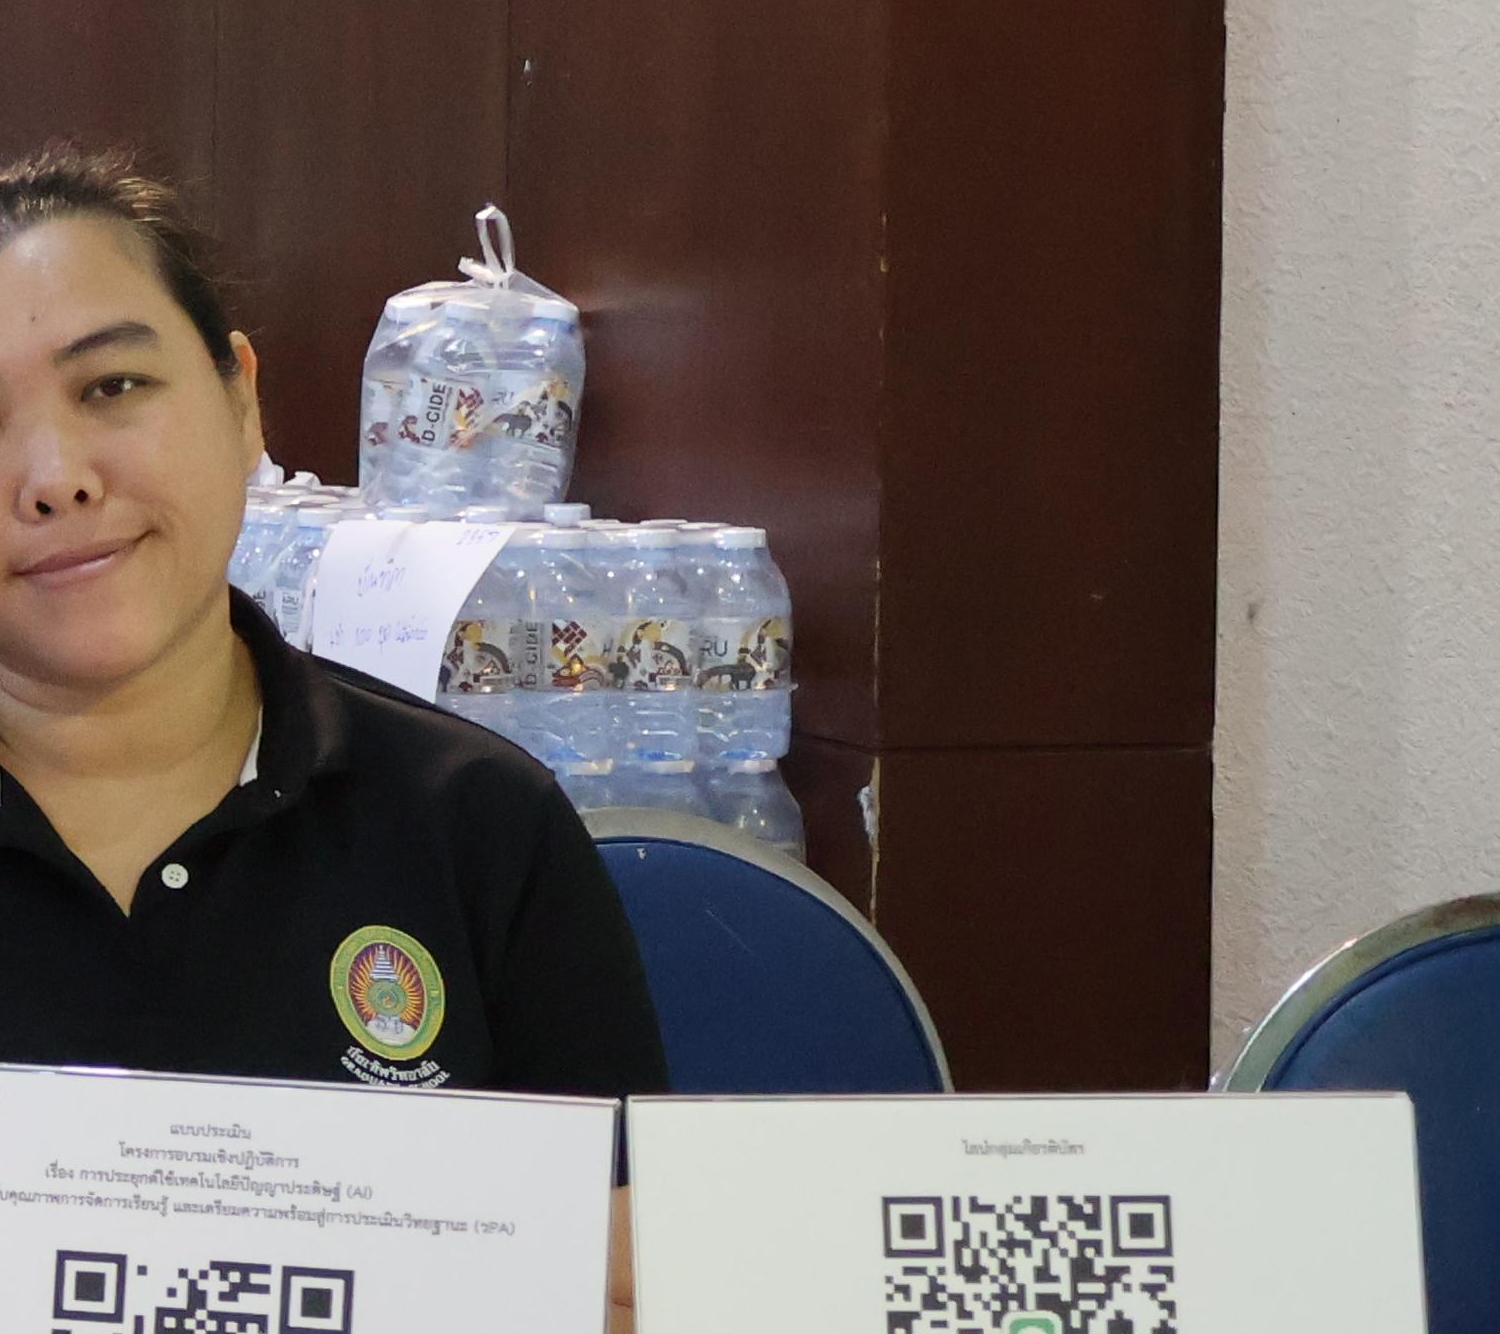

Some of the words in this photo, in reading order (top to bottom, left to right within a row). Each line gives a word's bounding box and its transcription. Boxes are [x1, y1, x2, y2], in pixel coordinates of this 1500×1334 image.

[421, 382, 448, 443] D-CIDE
[169, 1122, 252, 1141] แบบประเมิน
[118, 1140, 300, 1170] โครงการอบรมเชิงปฏิบัติการ
[44, 1161, 75, 1182] เรื่อง
[346, 1183, 373, 1201] (AI)
